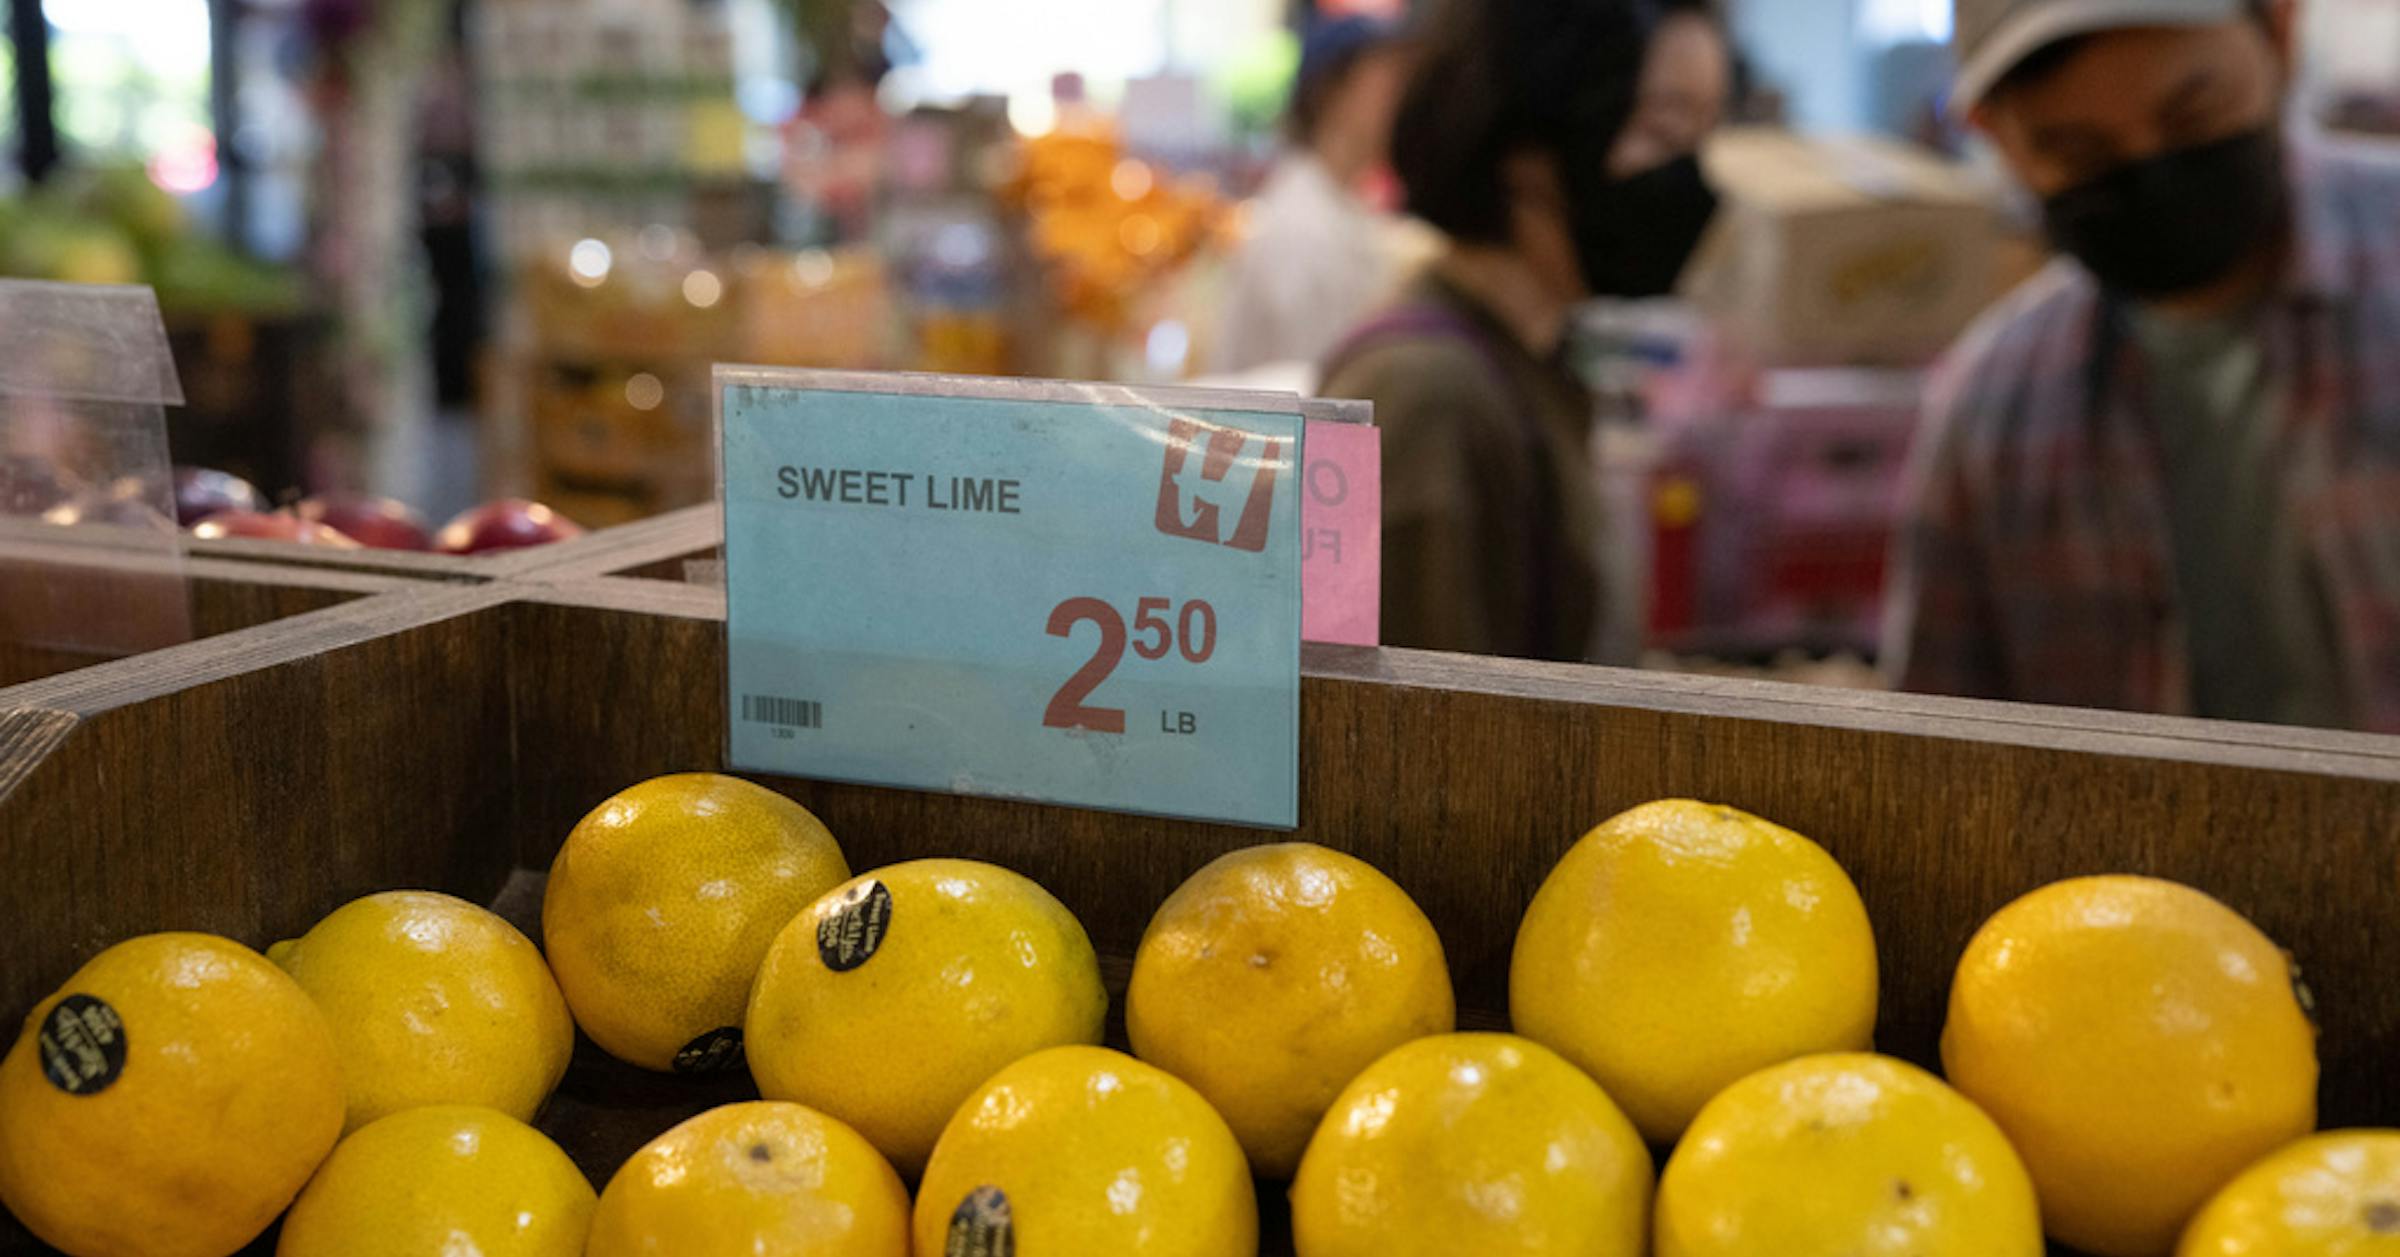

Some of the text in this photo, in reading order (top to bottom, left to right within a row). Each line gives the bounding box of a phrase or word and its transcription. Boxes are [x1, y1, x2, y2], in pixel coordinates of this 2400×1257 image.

[777, 466, 1020, 513] SWEET LIME
[1042, 596, 1217, 734] 2 50
[1161, 710, 1197, 735] LB
